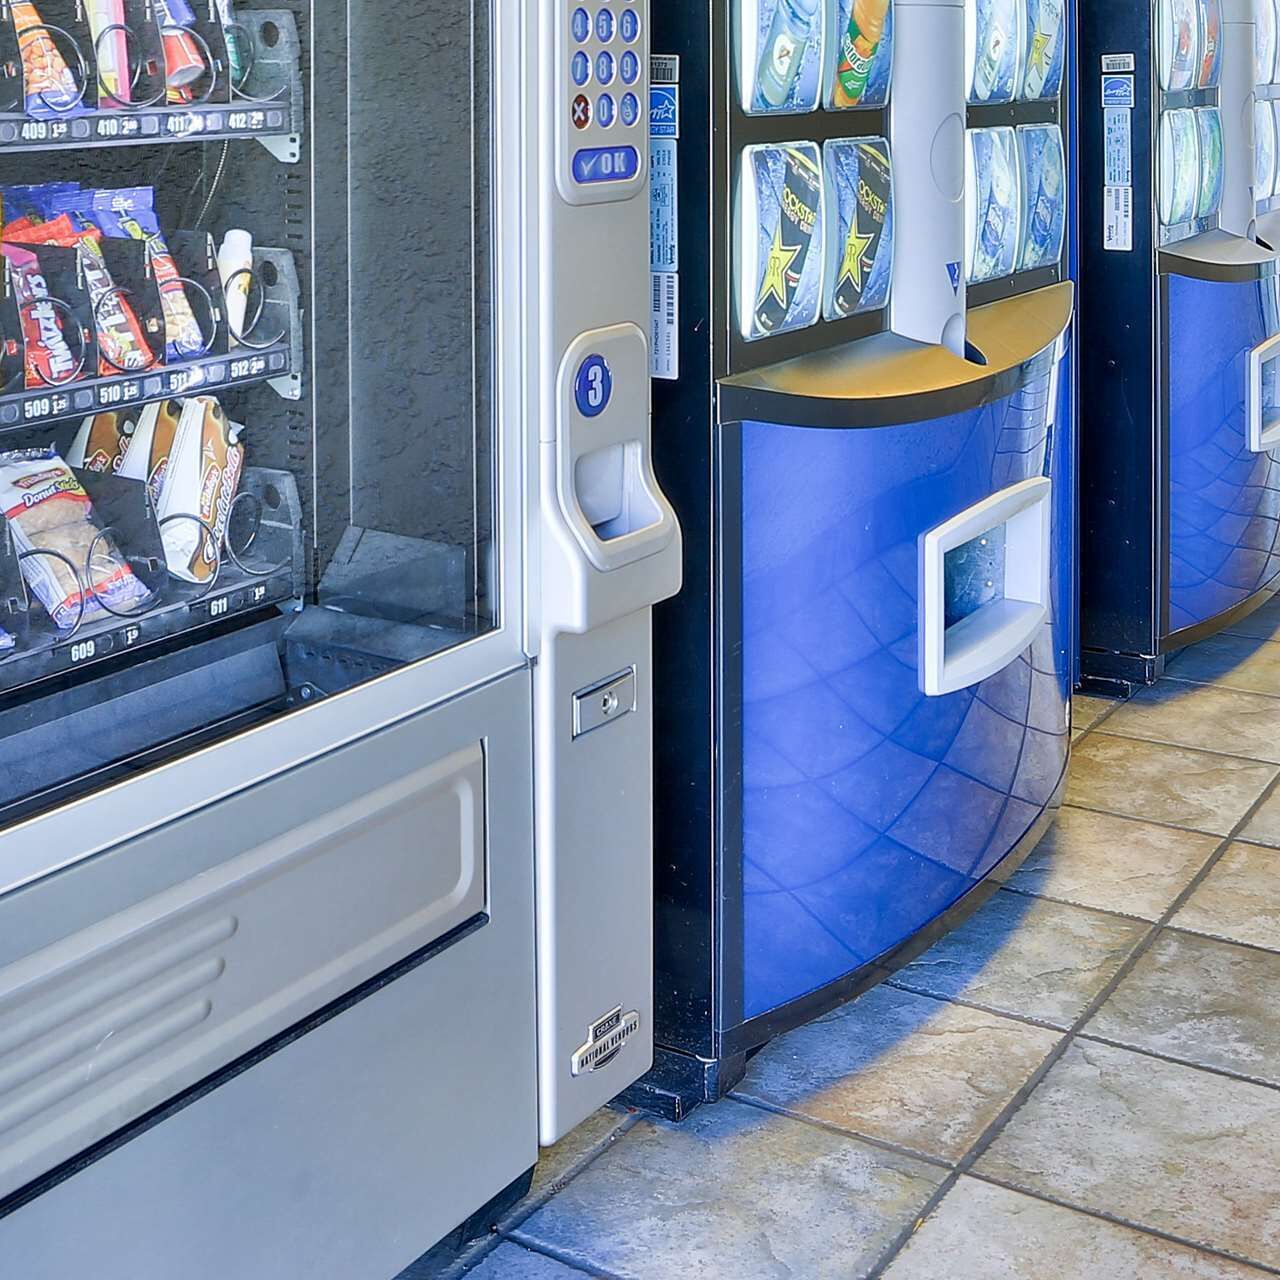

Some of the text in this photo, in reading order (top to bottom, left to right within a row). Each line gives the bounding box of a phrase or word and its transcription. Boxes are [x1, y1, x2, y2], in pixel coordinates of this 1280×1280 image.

[574, 15, 631, 37] 4 5 6
[574, 57, 631, 79] 7 8 9
[229, 113, 246, 129] 412
[600, 101, 608, 121] 0
[22, 122, 46, 140] 409
[97, 118, 118, 136] 410
[600, 152, 626, 175] OK
[231, 360, 249, 378] 512
[100, 385, 121, 404] 510
[586, 364, 603, 408] 3
[24, 398, 50, 417] 509
[22, 477, 81, 509] Donut Sticks
[210, 598, 228, 616] 611
[71, 640, 95, 660] 609
[580, 1040, 610, 1069] NATIONAL
